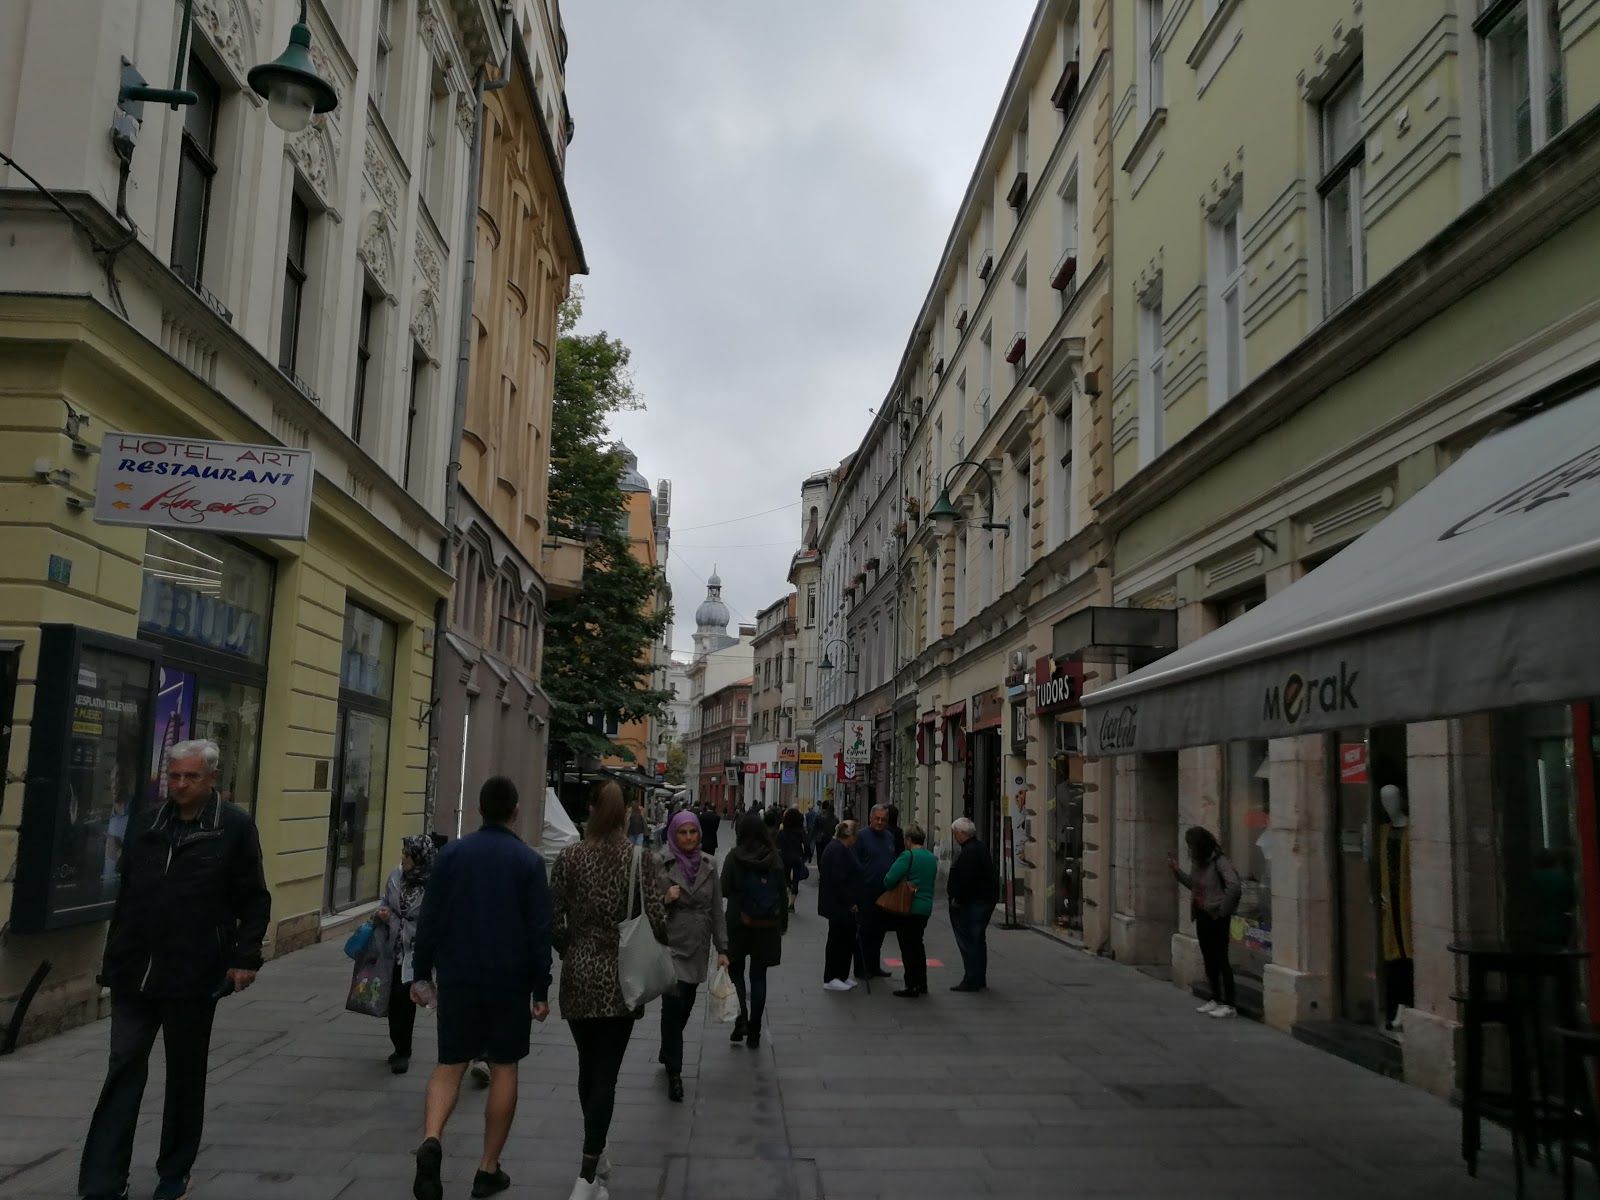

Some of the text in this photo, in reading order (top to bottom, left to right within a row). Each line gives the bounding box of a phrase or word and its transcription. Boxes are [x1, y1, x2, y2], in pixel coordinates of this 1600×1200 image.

[119, 438, 300, 468] HOTEL ART
[118, 458, 295, 486] RESTAURANT
[1036, 674, 1070, 708] TUDORS
[781, 746, 795, 755] dm
